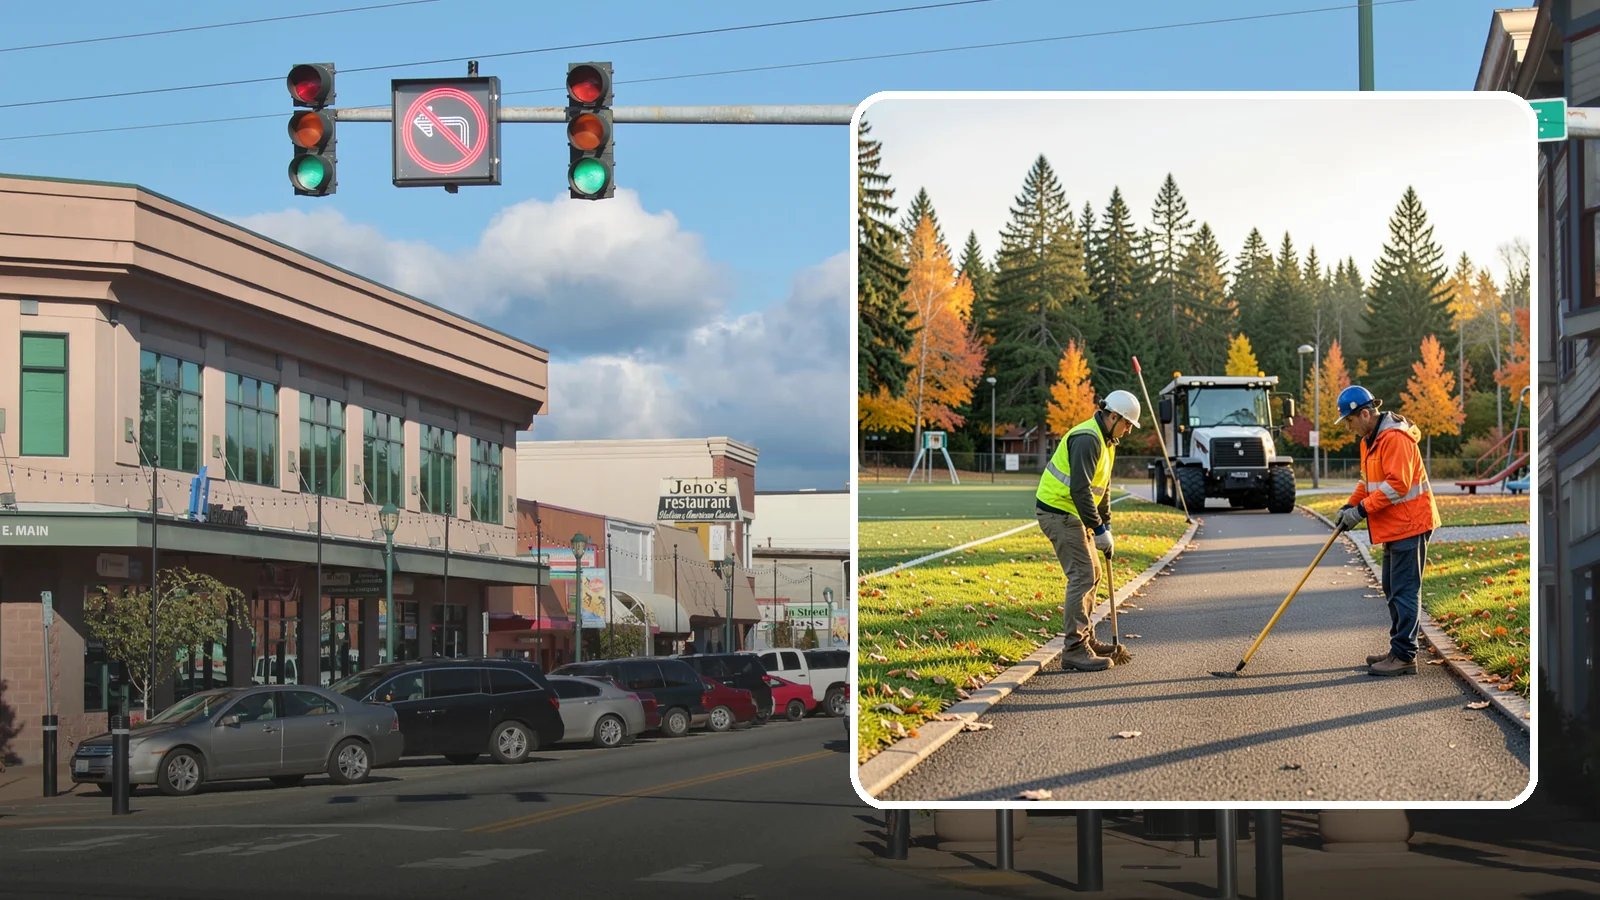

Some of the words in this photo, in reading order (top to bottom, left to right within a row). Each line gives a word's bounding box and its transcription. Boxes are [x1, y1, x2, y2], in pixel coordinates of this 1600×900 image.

[670, 480, 727, 494] Jeno's
[665, 497, 731, 509] restaurant
[659, 510, 681, 519] Italian
[686, 510, 714, 519] American
[715, 510, 738, 519] Cuisine
[2, 525, 13, 536] E.
[15, 525, 49, 536] MAIN
[797, 608, 828, 616] Street
